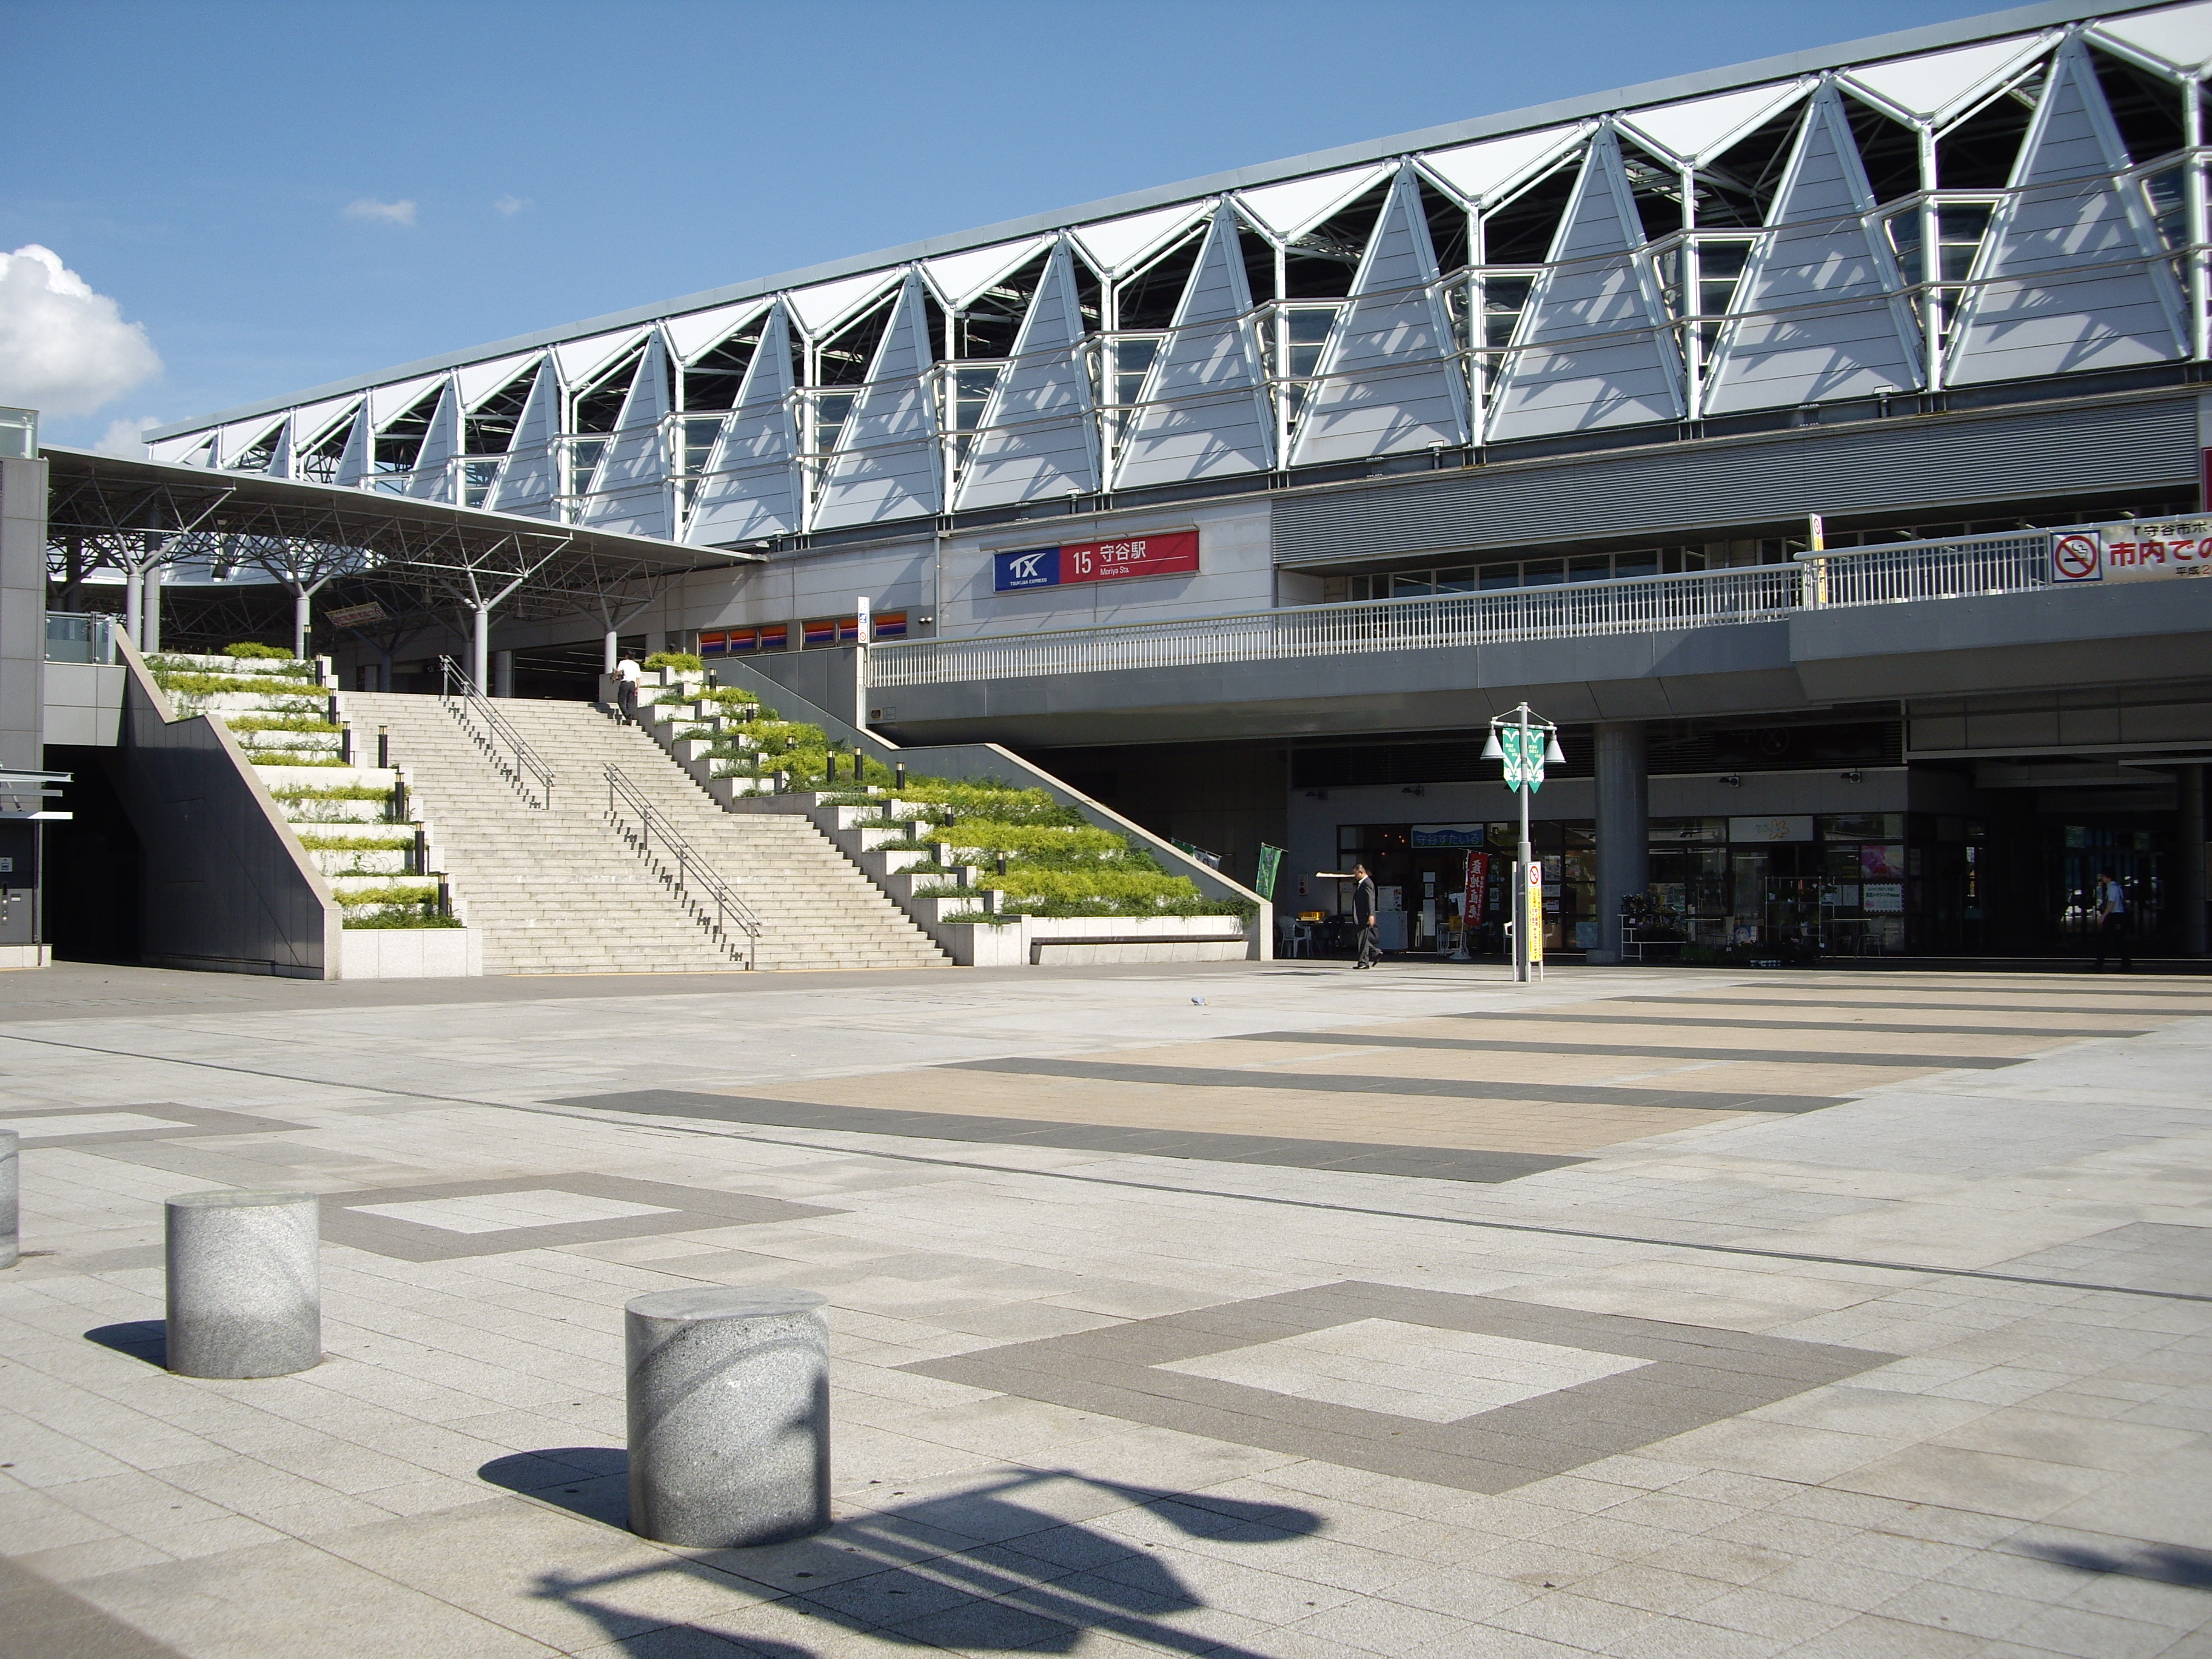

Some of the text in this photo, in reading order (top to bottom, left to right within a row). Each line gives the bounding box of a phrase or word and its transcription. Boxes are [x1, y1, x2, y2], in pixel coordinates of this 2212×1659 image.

[2133, 521, 2212, 537] 「守谷市ポ
[1073, 551, 1091, 574] 15
[1100, 540, 1146, 563] 守谷駅
[1010, 553, 1047, 578] TX
[1416, 834, 1480, 846] 守谷すたいる
